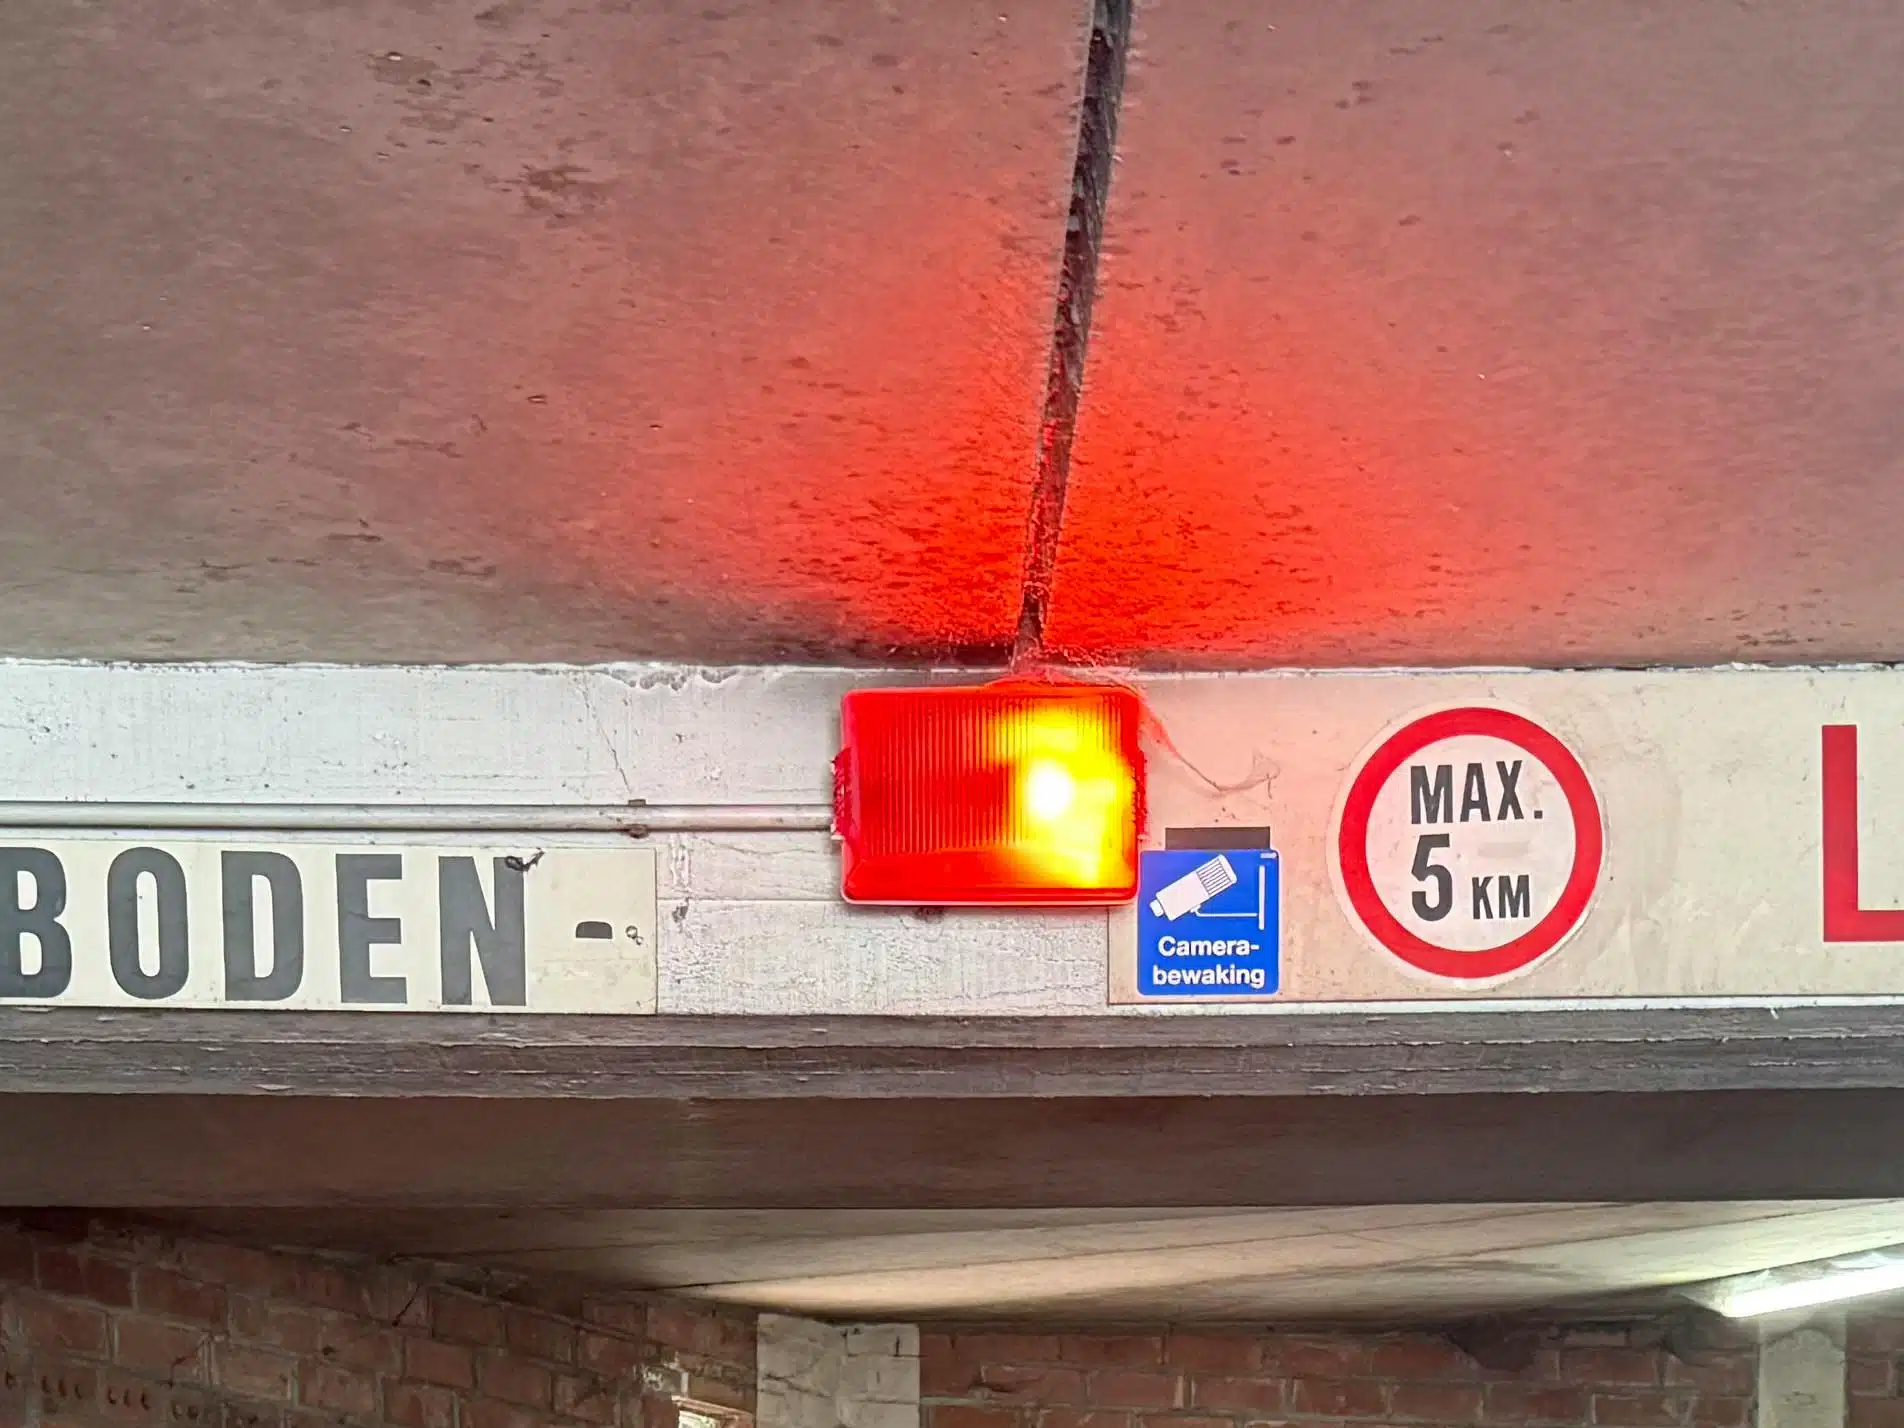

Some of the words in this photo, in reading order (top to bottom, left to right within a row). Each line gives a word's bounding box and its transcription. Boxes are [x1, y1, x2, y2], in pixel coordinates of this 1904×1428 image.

[1409, 759, 1545, 825] MAX.
[1411, 834, 1452, 922] 5
[1472, 875, 1531, 920] KM
[1158, 935, 1260, 957] Camera-
[1152, 964, 1265, 989] bewaking
